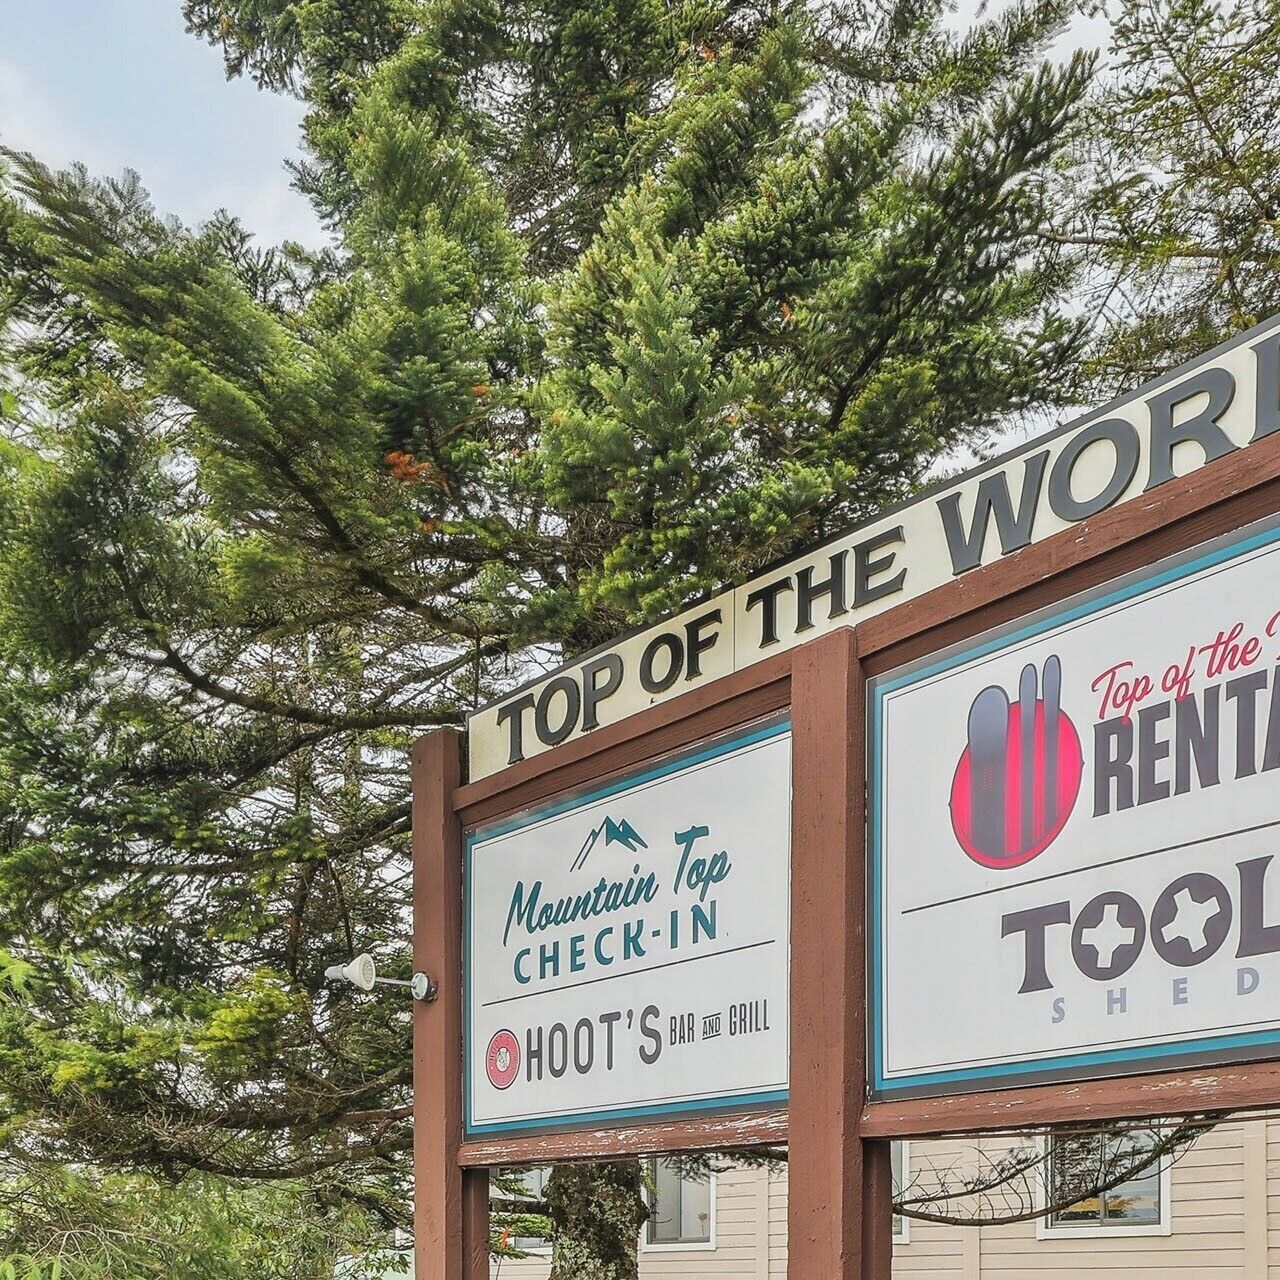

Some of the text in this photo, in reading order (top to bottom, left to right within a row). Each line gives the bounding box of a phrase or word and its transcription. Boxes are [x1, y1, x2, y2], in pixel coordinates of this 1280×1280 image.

[496, 653, 624, 765] TOP
[639, 608, 723, 693] OF
[746, 525, 908, 648] THE
[1091, 661, 1154, 726] Top
[1161, 646, 1195, 701] of
[1199, 622, 1263, 679] the
[503, 826, 732, 947] Mountain Top
[513, 900, 717, 984] CHECK-IN
[526, 1004, 663, 1082] HOOT'S
[670, 1013, 695, 1046] BAR
[702, 1015, 722, 1039] AND
[729, 999, 771, 1037] GRILL
[1051, 966, 1261, 1024] SHED
